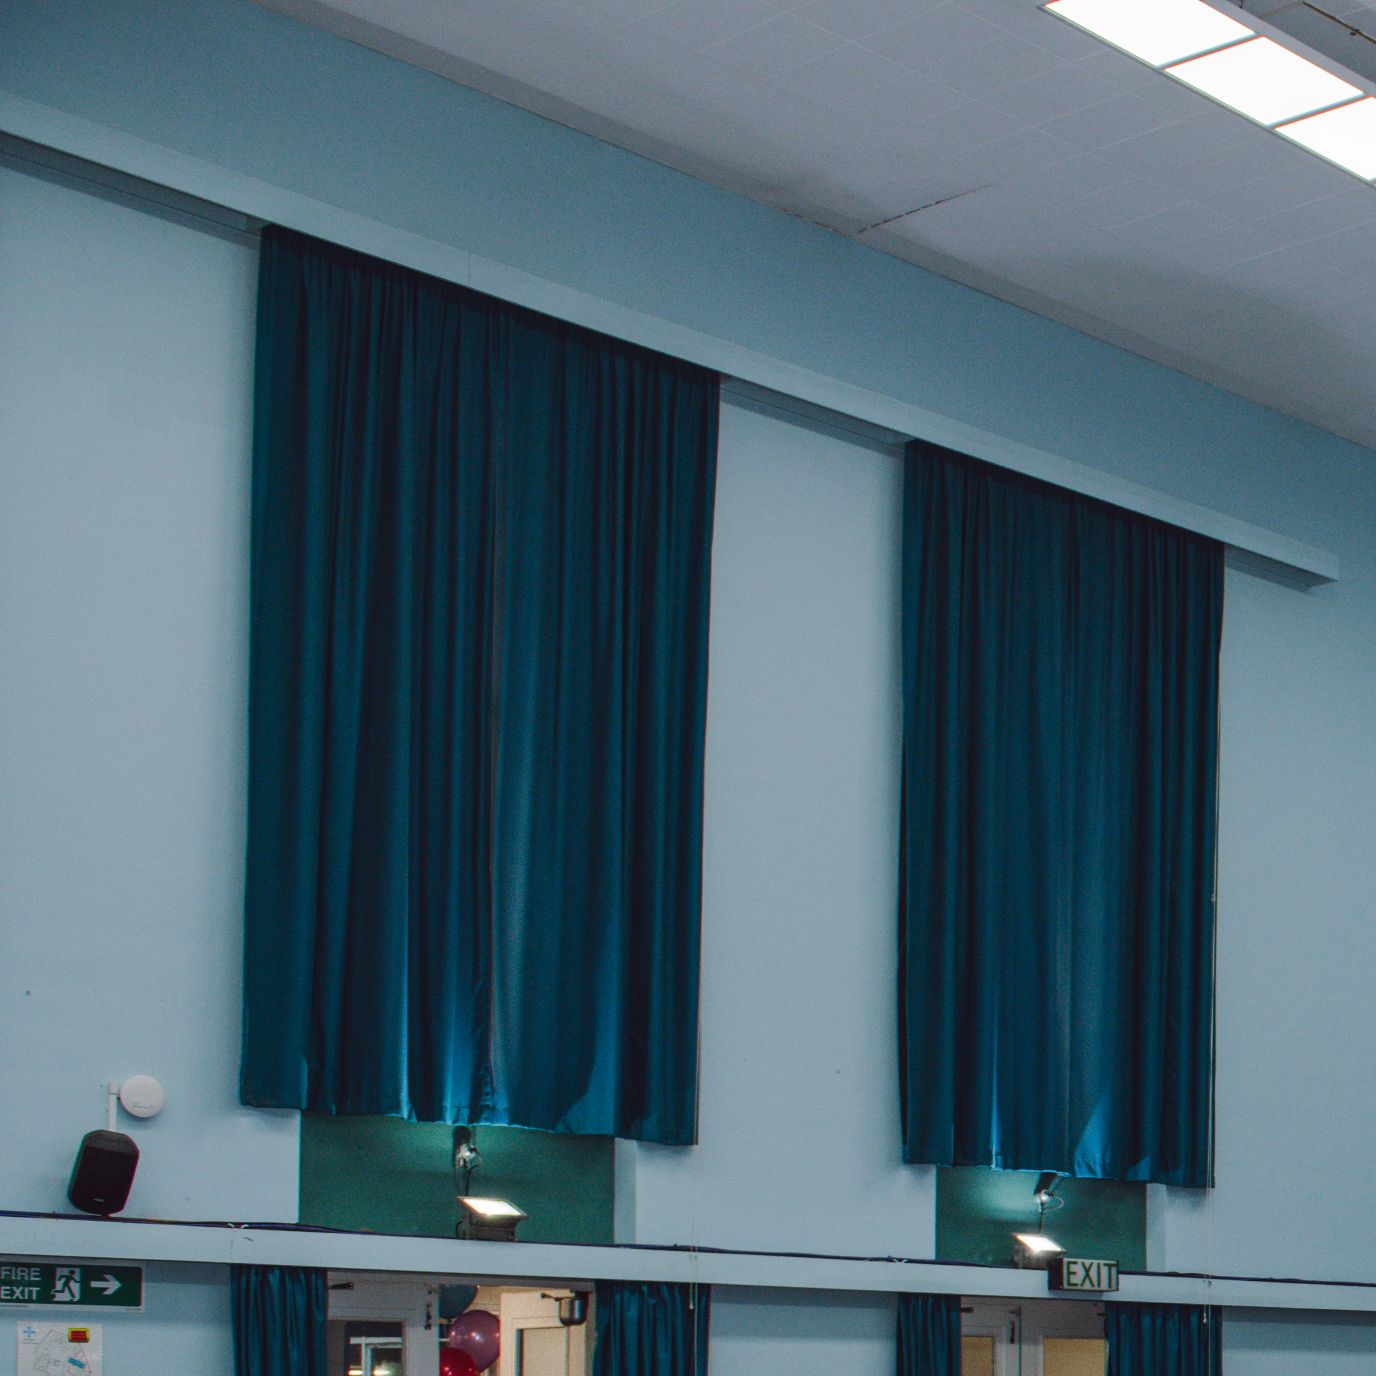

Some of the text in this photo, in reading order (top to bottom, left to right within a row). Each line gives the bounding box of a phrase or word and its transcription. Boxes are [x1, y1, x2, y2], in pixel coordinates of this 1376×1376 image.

[0, 1266, 41, 1281] FIRE
[1067, 1260, 1116, 1289] EXIT
[0, 1286, 41, 1300] EXIT
